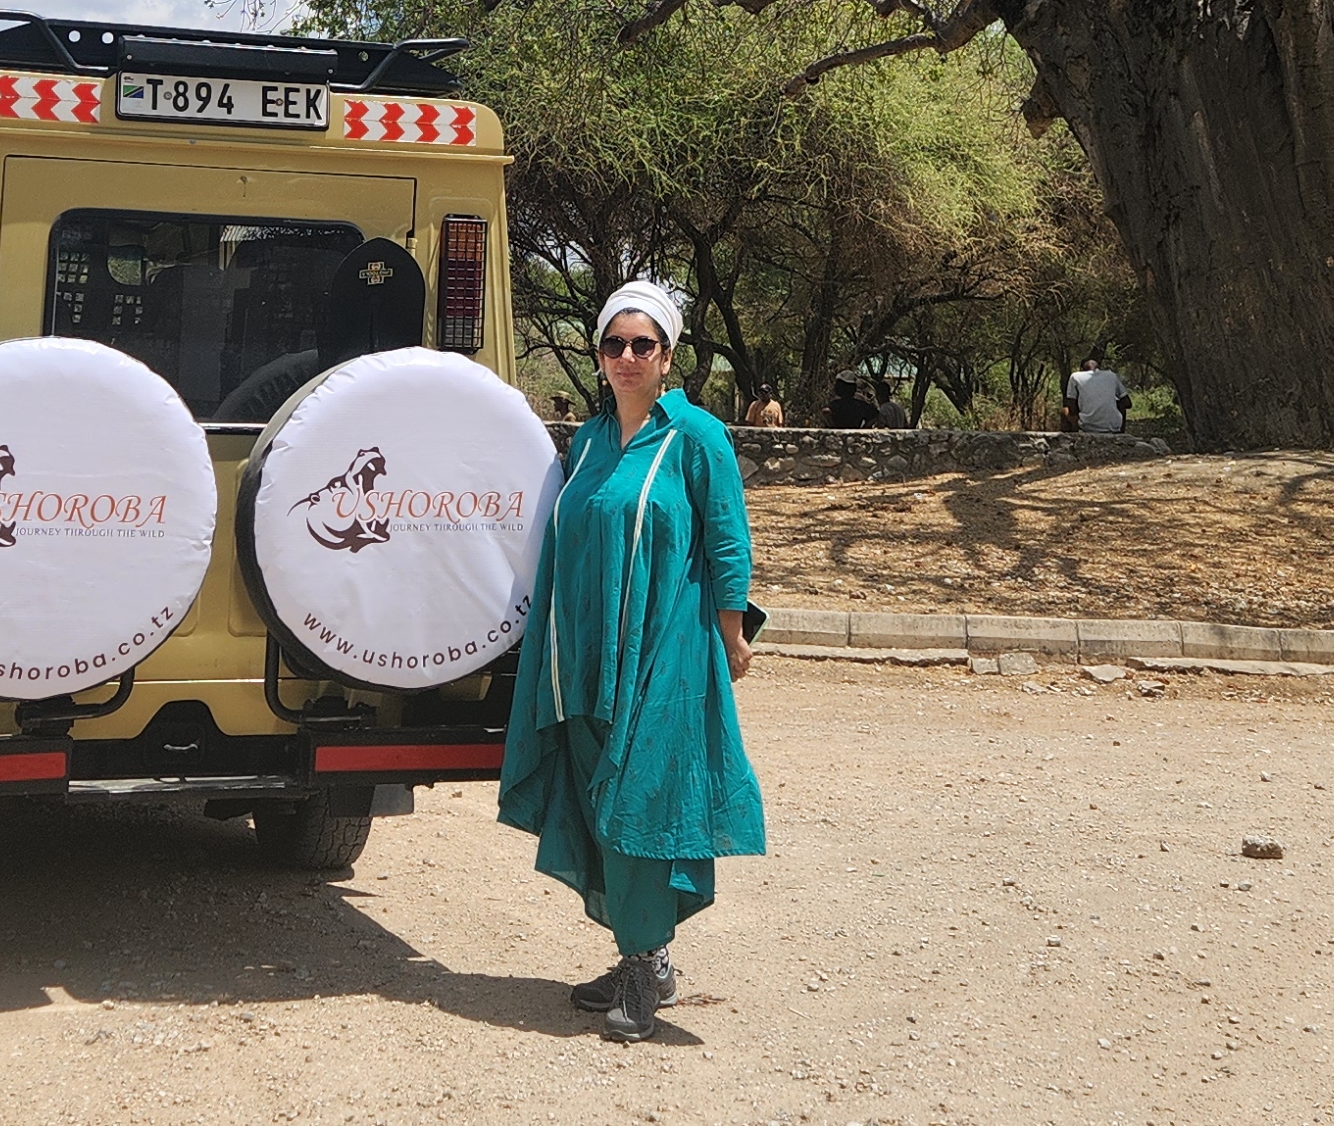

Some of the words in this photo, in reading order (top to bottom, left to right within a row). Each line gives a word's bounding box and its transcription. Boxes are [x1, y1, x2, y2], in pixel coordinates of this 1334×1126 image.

[172, 80, 234, 115] 894
[261, 85, 323, 120] EEK
[331, 489, 524, 524] USHOROBA
[15, 527, 61, 536] JOURNEY
[64, 527, 113, 537] THROUGH
[117, 529, 136, 537] THE
[139, 529, 165, 538] WILD
[389, 523, 430, 532] JOURNEY
[434, 523, 477, 531] THROUGH
[481, 523, 496, 531] THE
[499, 523, 524, 531] WILD
[303, 594, 532, 669] www.ushoroba.co.tz
